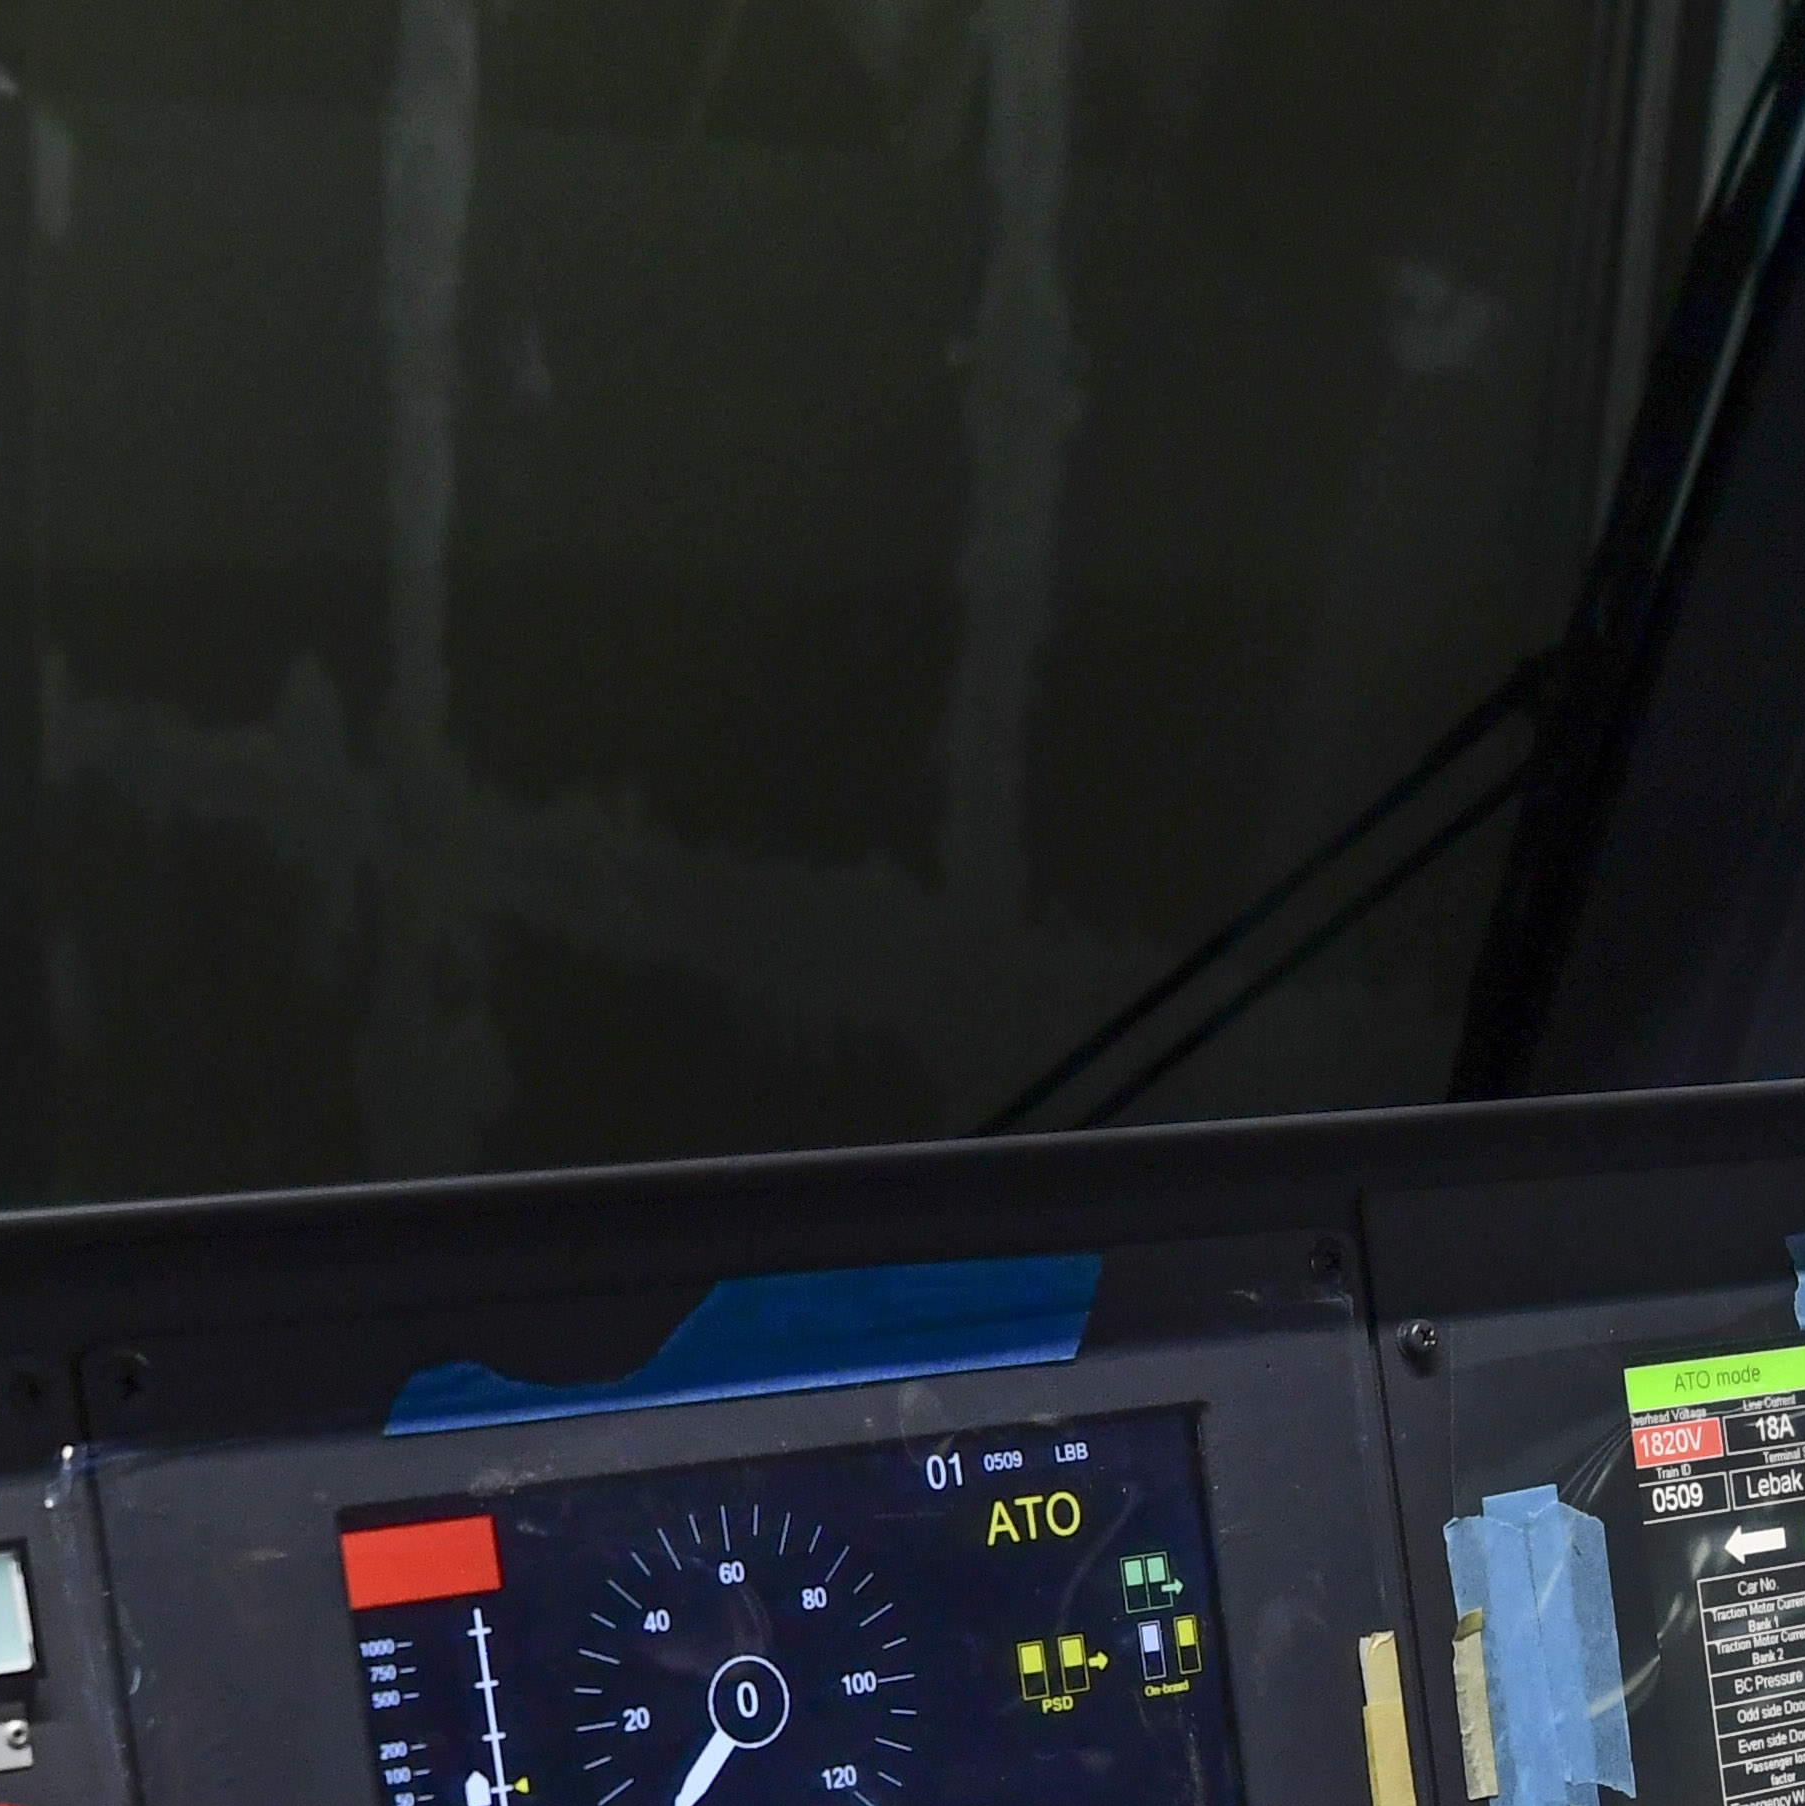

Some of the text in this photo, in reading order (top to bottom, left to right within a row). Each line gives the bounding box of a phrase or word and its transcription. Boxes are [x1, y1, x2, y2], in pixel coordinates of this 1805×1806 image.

[1674, 1364, 1761, 1392] ATO mode
[1754, 1413, 1795, 1442] 18A
[1054, 1442, 1089, 1463] LBB
[1639, 1426, 1702, 1458] 1820V
[983, 1450, 1023, 1472] 0509
[1762, 1447, 1801, 1464] Terminal
[926, 1452, 963, 1490] 01
[1746, 1468, 1804, 1499] Lebak
[1652, 1482, 1704, 1513] 0509
[987, 1491, 1081, 1546] ATO
[718, 1561, 745, 1585] 60
[802, 1586, 827, 1610] 80
[1737, 1577, 1777, 1597] Car No.
[643, 1609, 670, 1633] 40
[360, 1639, 396, 1657] 1000
[370, 1664, 397, 1682] 750
[841, 1671, 877, 1695] 100
[1734, 1670, 1804, 1695] BC Pressure
[372, 1690, 400, 1709] 500
[736, 1681, 759, 1718] 0
[1041, 1695, 1074, 1713] PSD
[623, 1707, 651, 1732] 20
[1737, 1706, 1760, 1724] Odd
[1761, 1703, 1783, 1720] side
[1737, 1738, 1765, 1754] Even
[1765, 1732, 1788, 1748] side
[821, 1765, 857, 1790] 120
[1770, 1772, 1796, 1786] factor
